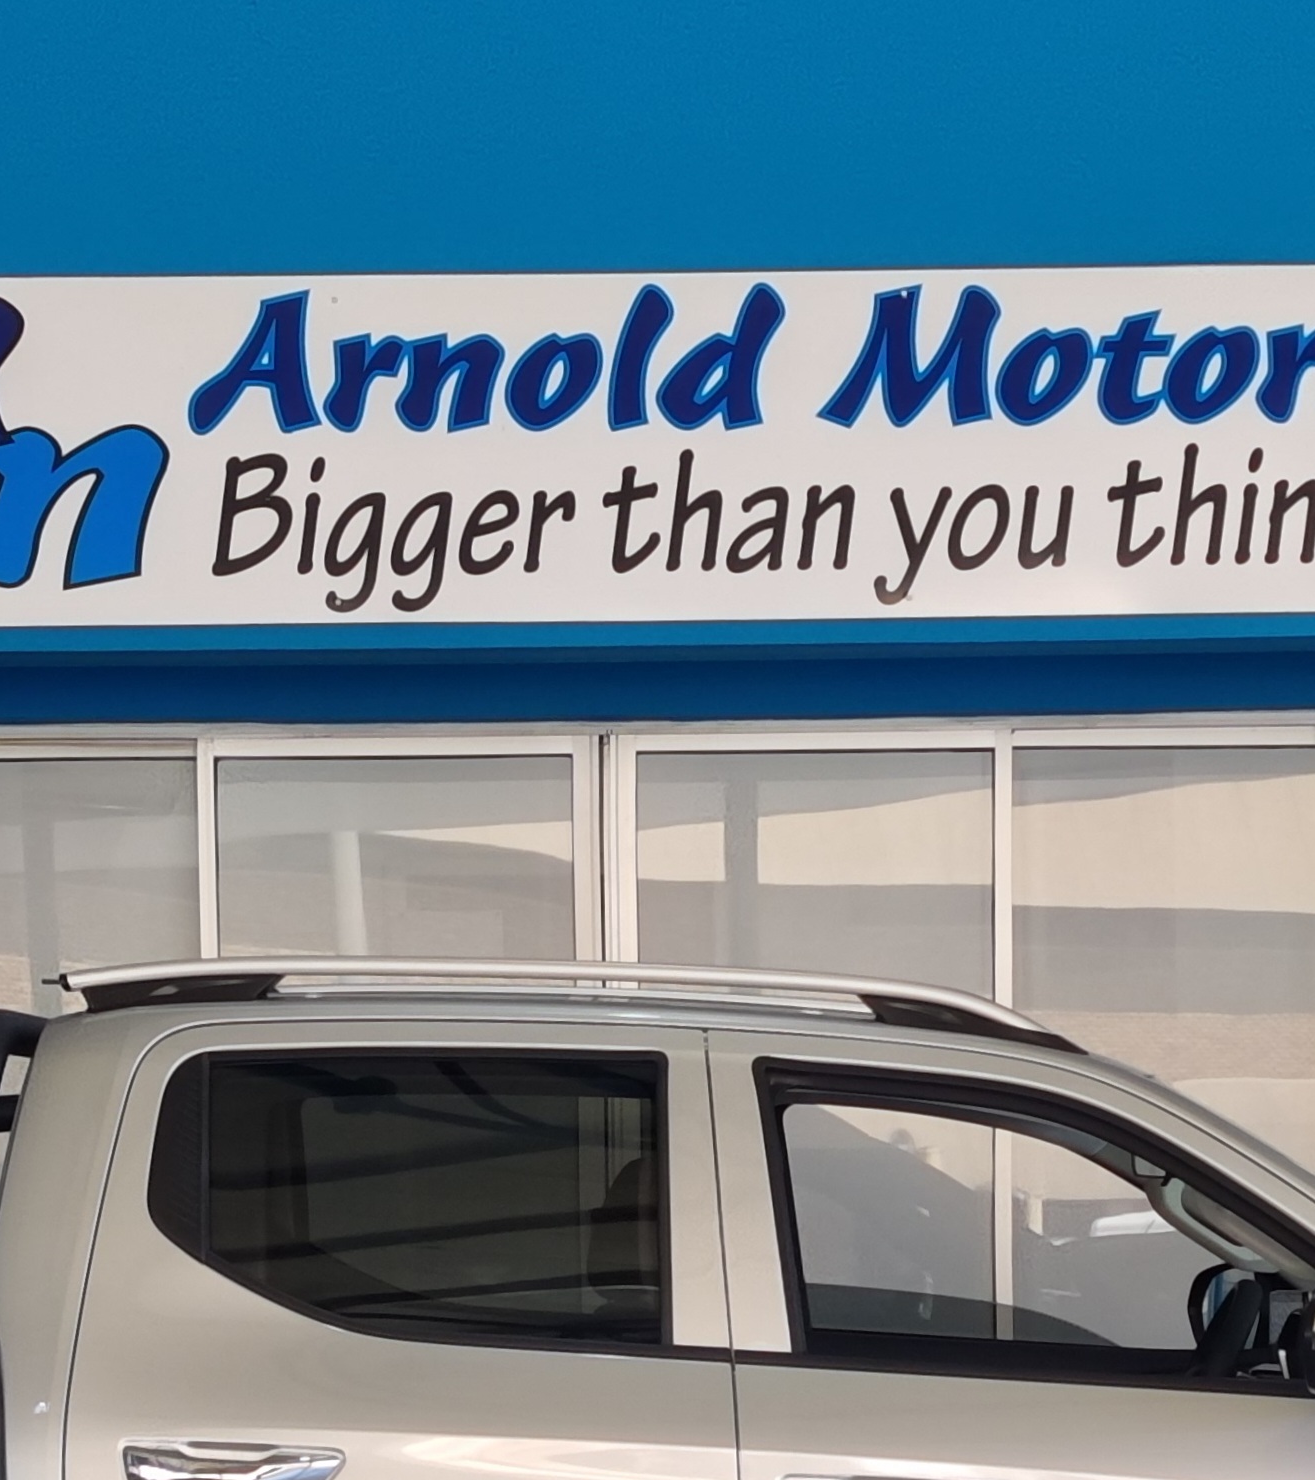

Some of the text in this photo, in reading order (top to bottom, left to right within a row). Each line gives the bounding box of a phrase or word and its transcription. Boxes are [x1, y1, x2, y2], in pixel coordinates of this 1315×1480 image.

[187, 282, 783, 434] Arnold
[212, 454, 574, 613] Bigger
[602, 450, 855, 575] than
[875, 466, 1067, 604] you
